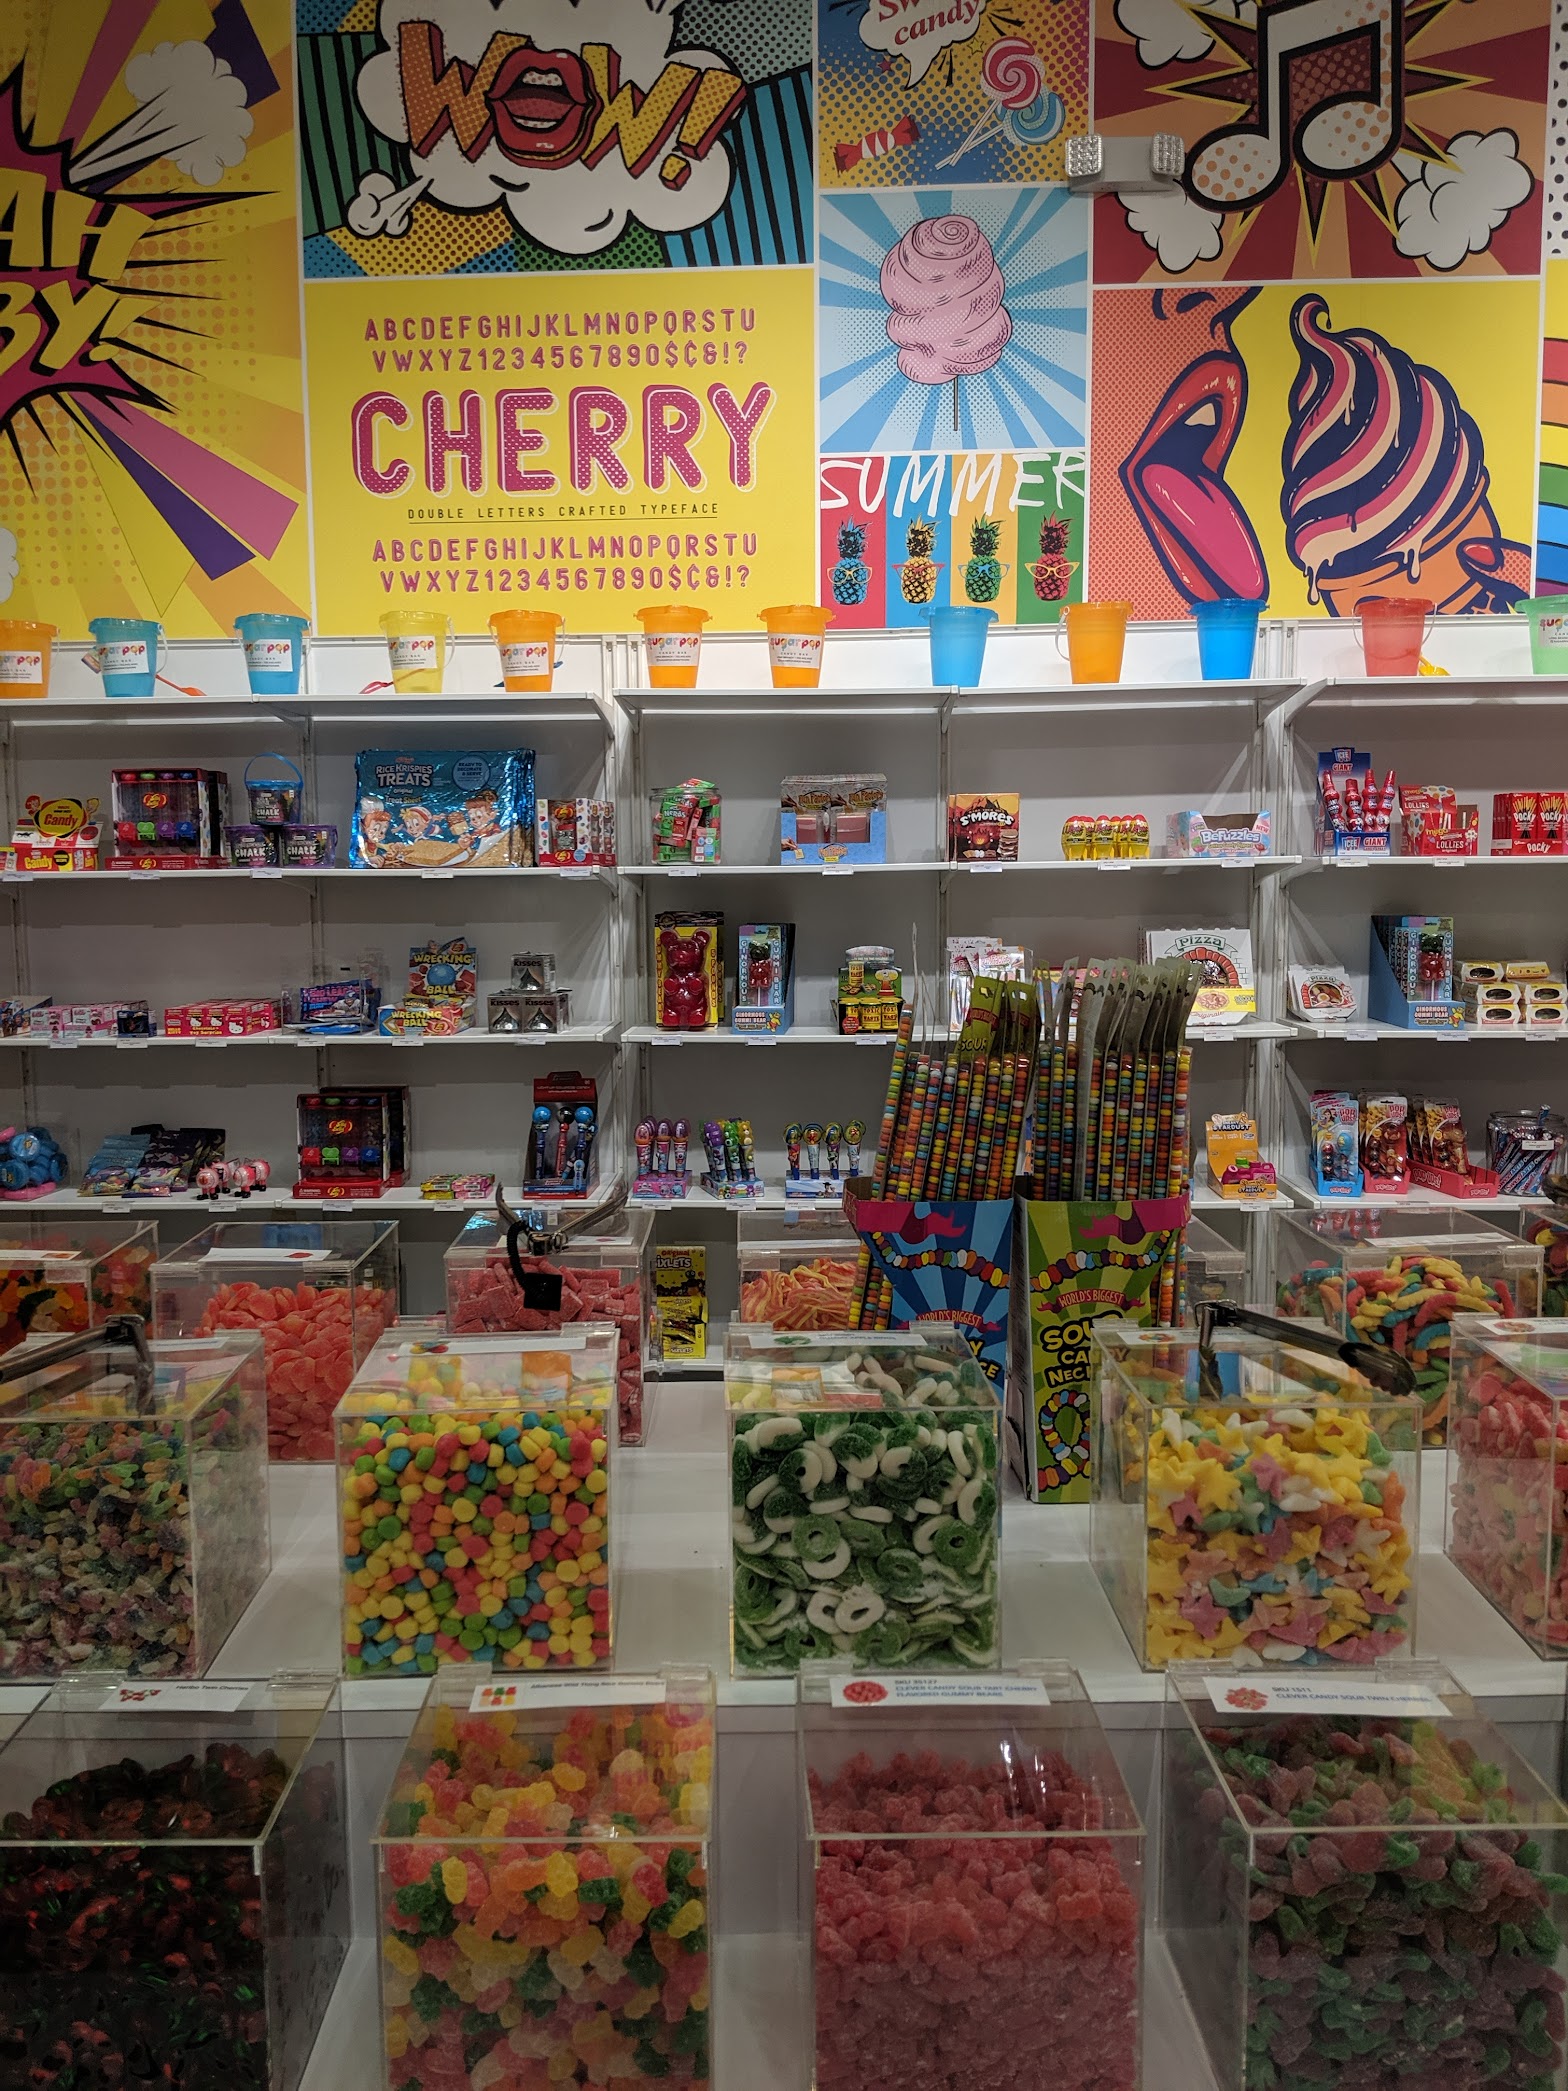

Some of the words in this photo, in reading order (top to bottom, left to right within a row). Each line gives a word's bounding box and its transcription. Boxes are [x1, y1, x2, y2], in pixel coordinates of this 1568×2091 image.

[894, 0, 979, 45] candy
[351, 381, 776, 500] CHERRY
[820, 450, 1085, 518] SUMMER
[408, 508, 464, 519] DOUBLE
[477, 506, 546, 518] LETTERS
[558, 505, 627, 517] CRAFTED
[640, 503, 719, 516] TYPEFACE
[267, 643, 290, 654] pop
[411, 640, 435, 651] pop
[647, 636, 678, 650] sugar
[679, 636, 699, 649] pop
[769, 637, 800, 651] sugar
[801, 638, 821, 651] pop
[122, 645, 146, 656] pop
[526, 646, 548, 658] pop
[17, 655, 41, 666] pop
[375, 765, 395, 774] RICE
[395, 763, 433, 775] KRISPIES
[1332, 763, 1353, 771] GIANT
[377, 773, 432, 787] TREATS
[256, 808, 280, 816] CHALK
[1513, 812, 1537, 822] POCKY
[1540, 812, 1563, 822] POCKY
[44, 813, 79, 830] Candy
[1344, 838, 1358, 848] ICEE
[1363, 837, 1387, 846] GIANT
[1436, 840, 1464, 848] LOLLIES
[1526, 842, 1551, 854] POCKY
[235, 848, 266, 857] CHALK
[286, 845, 317, 855] CHALK
[24, 855, 52, 870] Candy
[413, 954, 472, 964] WRECKING
[772, 940, 780, 974] GUMMI
[426, 985, 456, 994] BALL
[772, 976, 780, 1004] BEAR
[391, 1011, 443, 1019] WRECKING
[403, 1019, 429, 1027] BALL
[1058, 1289, 1093, 1308] WORLD'S
[1092, 1289, 1125, 1305] BIGGEST
[951, 1311, 982, 1329] BIGGEST
